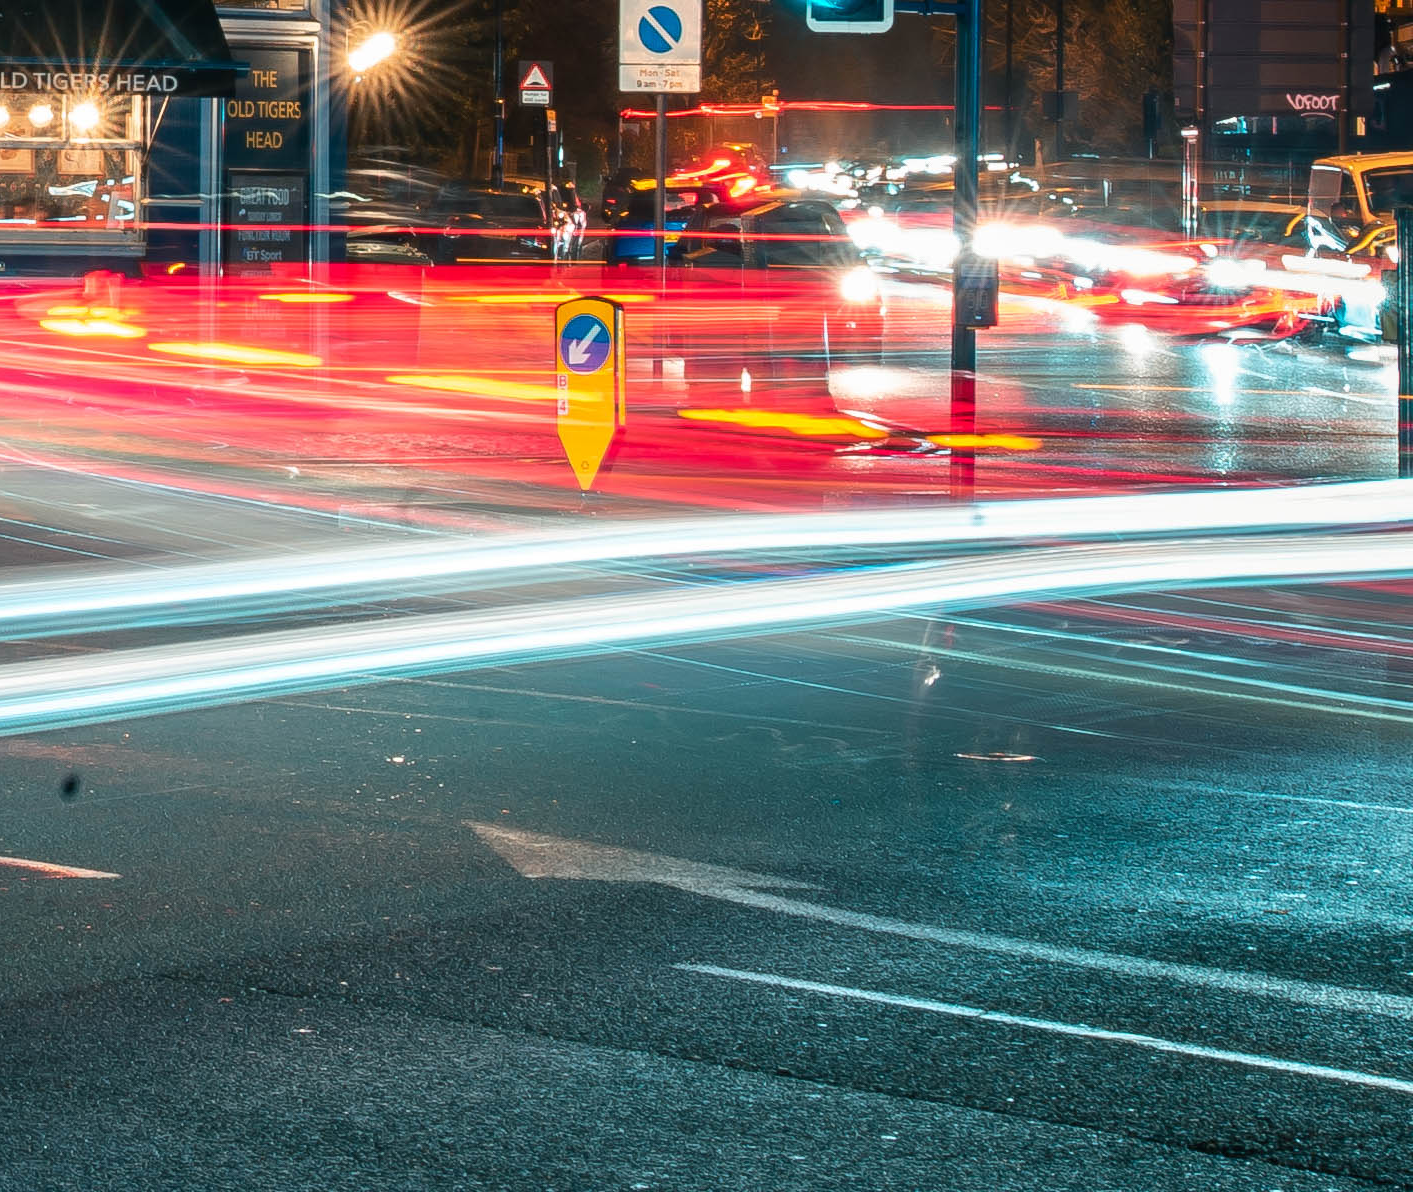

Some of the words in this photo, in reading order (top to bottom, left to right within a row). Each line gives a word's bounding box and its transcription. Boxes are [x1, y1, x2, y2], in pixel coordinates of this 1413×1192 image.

[33, 72, 110, 91] TIGERS
[116, 74, 178, 92] HEAD
[253, 70, 278, 88] THE
[639, 69, 659, 77] Mon
[664, 69, 680, 77] Sat
[227, 100, 255, 118] OLD
[256, 101, 302, 119] TIGERS
[246, 131, 283, 149] HEAD
[246, 250, 259, 260] BT
[261, 250, 283, 262] Sport
